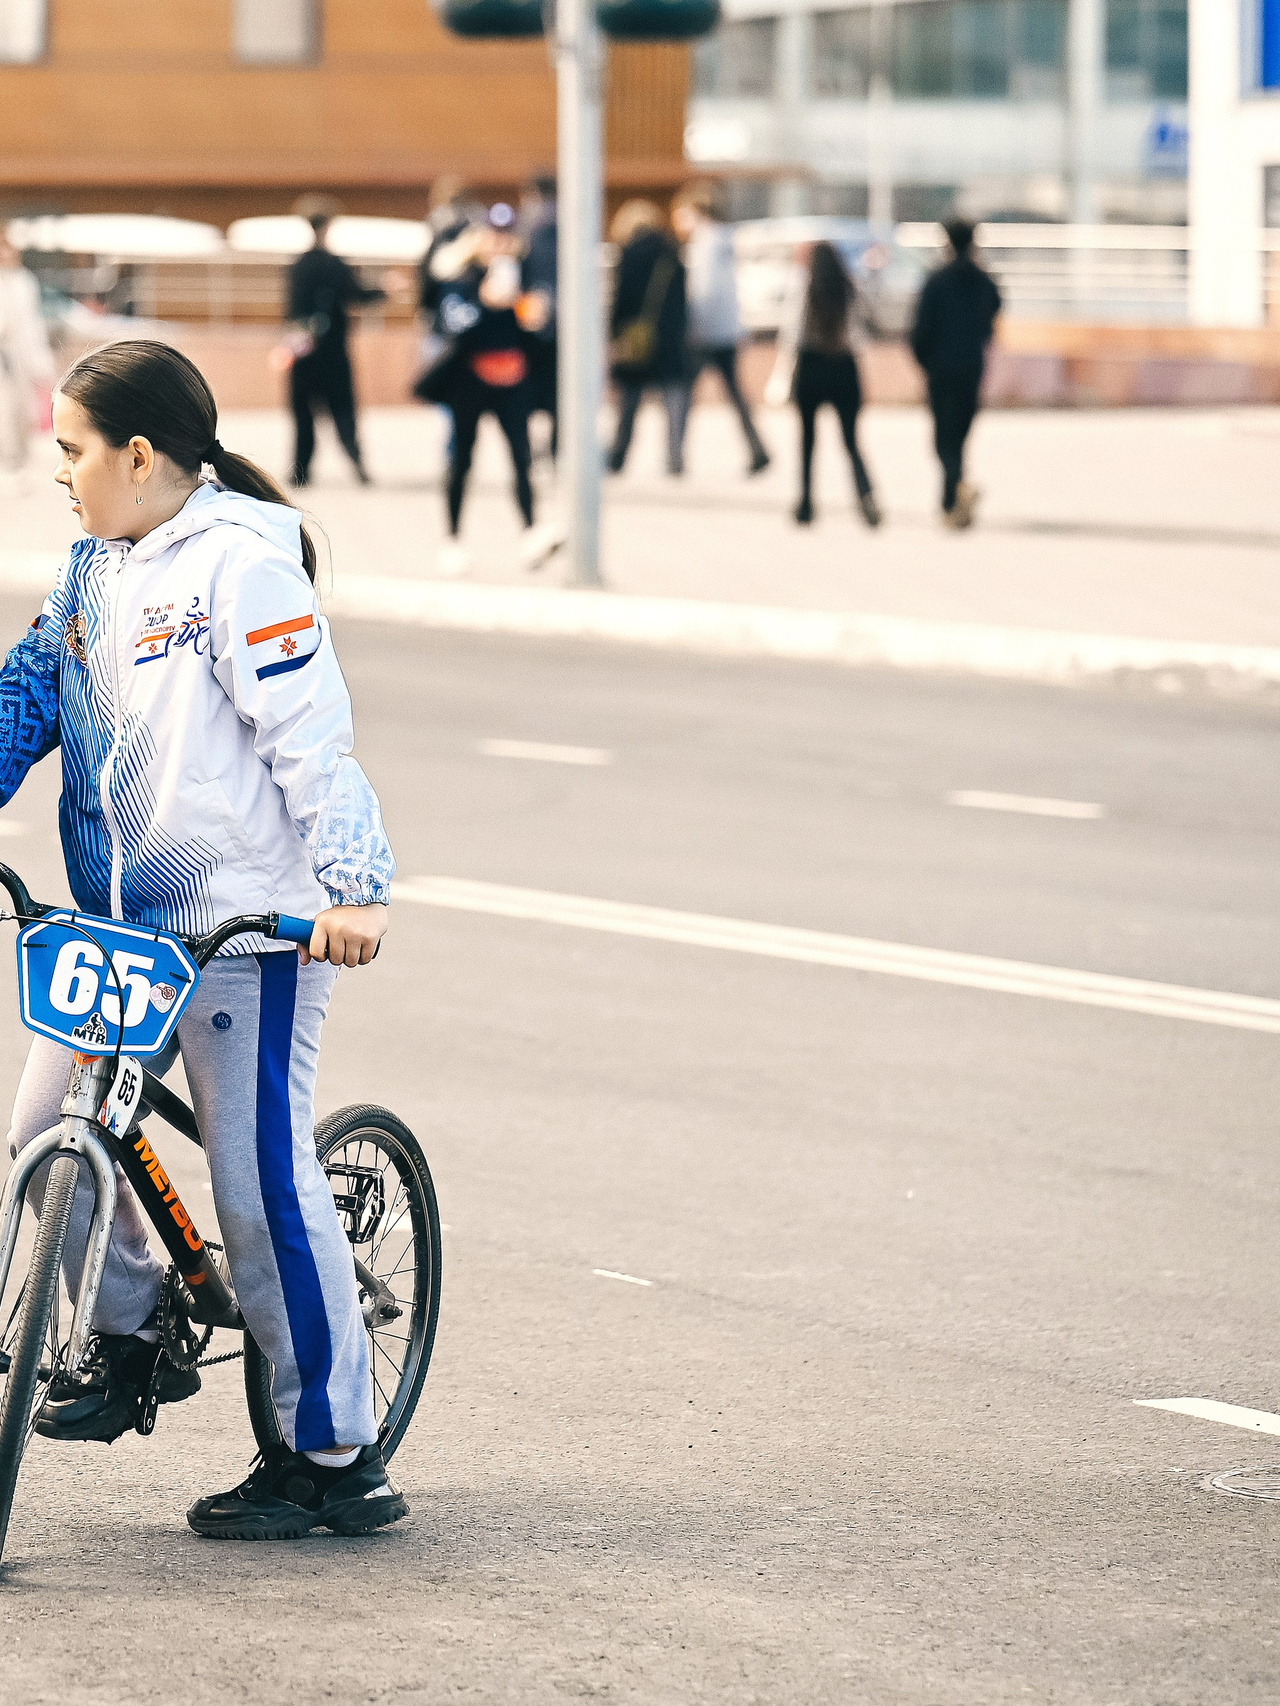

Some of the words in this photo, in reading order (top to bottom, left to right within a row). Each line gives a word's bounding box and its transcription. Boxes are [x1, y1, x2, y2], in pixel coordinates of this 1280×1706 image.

[49, 940, 155, 1028] 65
[73, 1028, 106, 1045] MTB
[118, 1068, 137, 1107] 65
